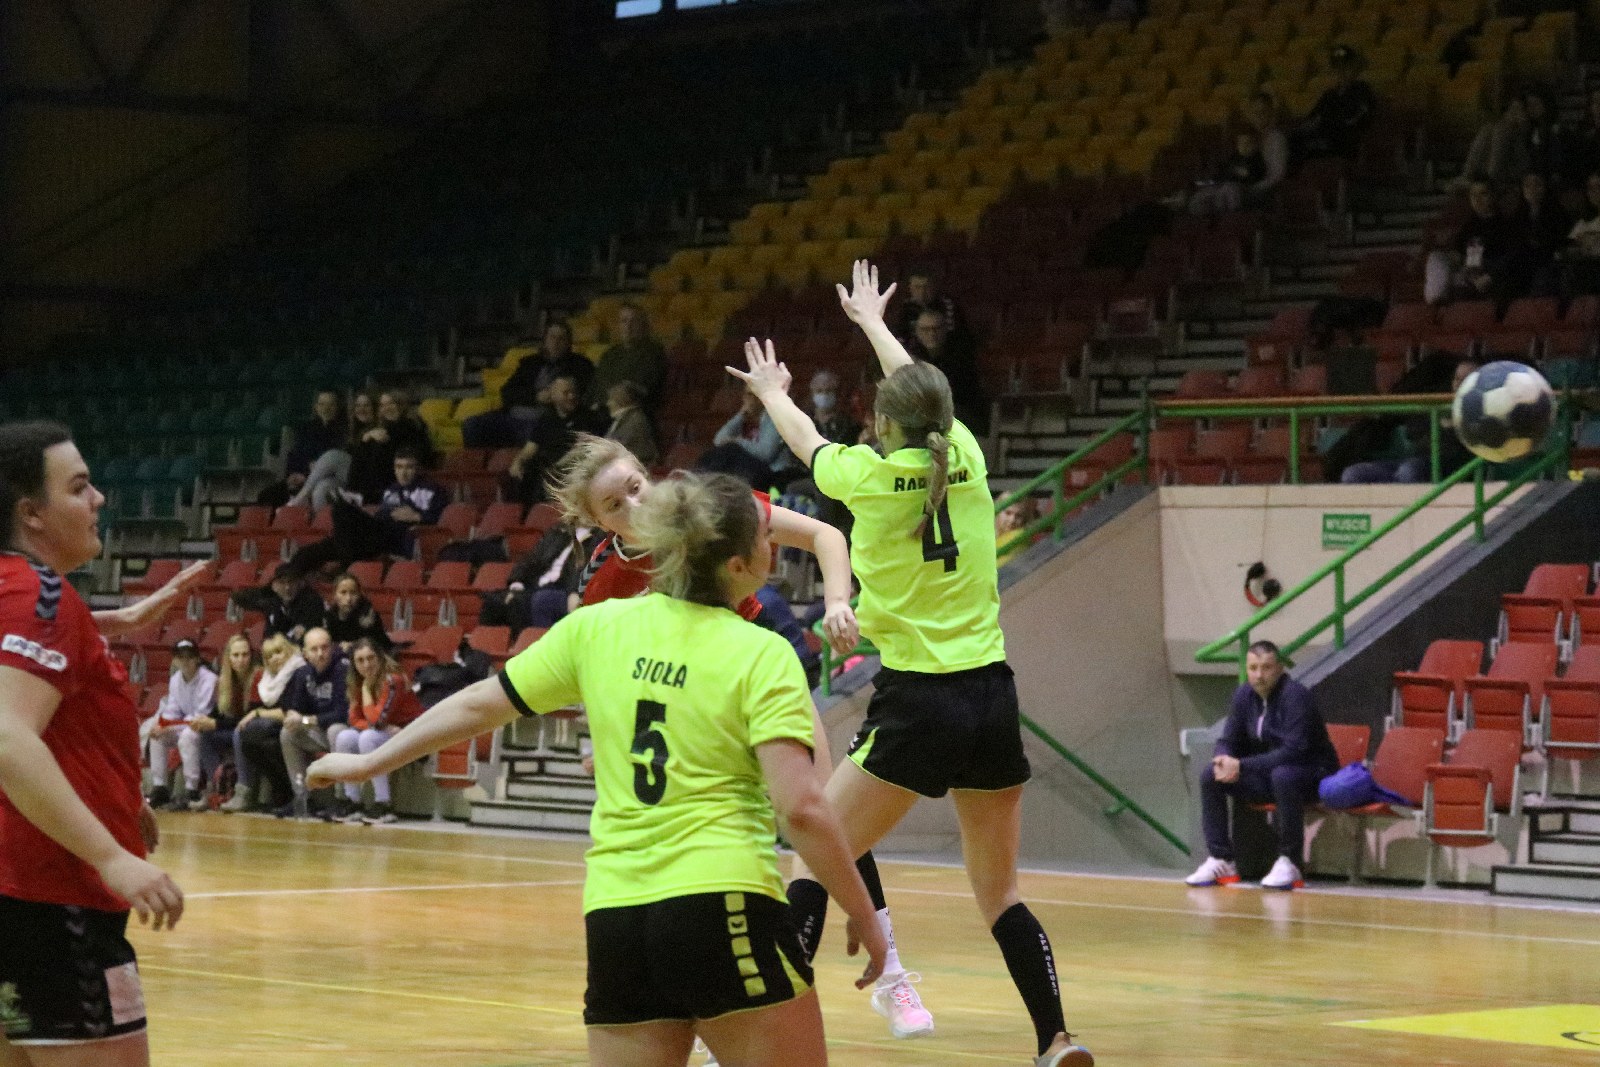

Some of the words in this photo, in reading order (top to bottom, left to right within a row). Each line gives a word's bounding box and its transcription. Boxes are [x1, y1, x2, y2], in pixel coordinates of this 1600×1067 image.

[922, 490, 959, 573] 4
[632, 657, 688, 689] SIOŁA
[630, 699, 669, 806] 5
